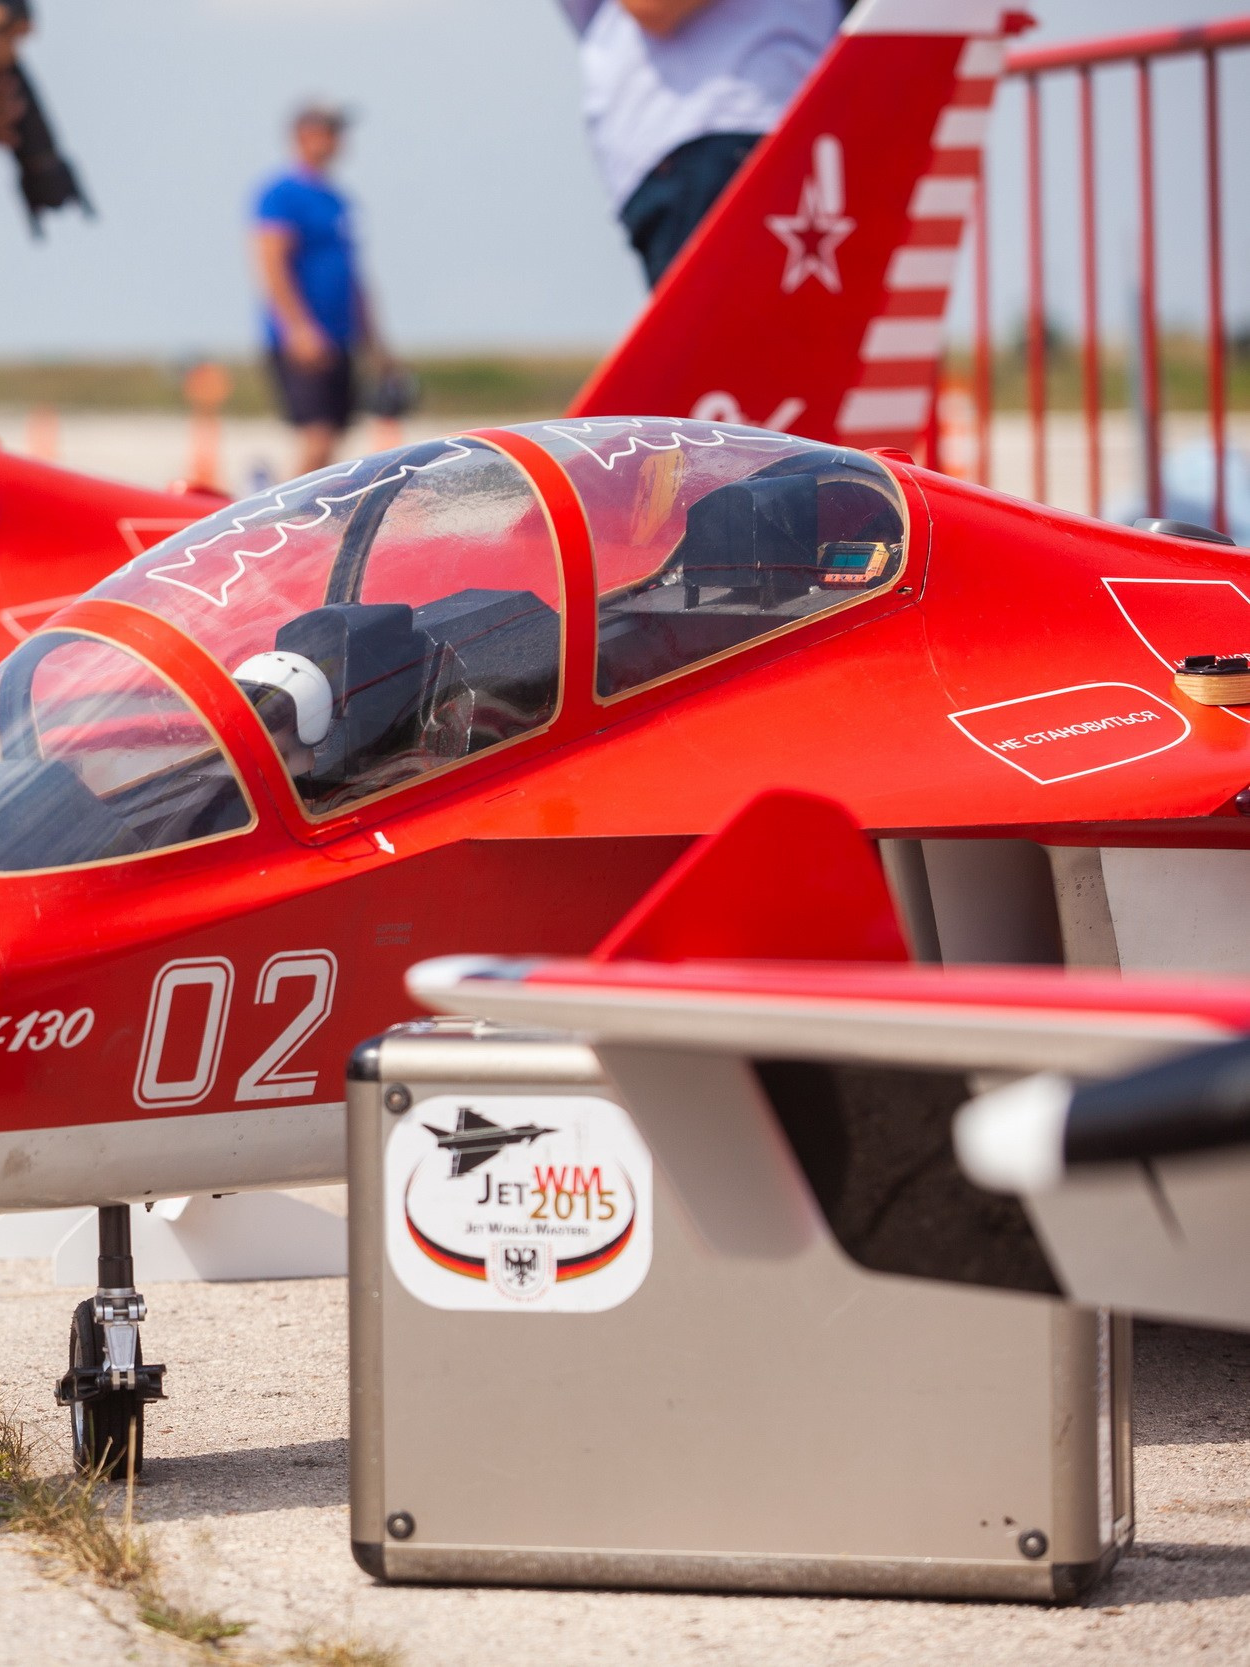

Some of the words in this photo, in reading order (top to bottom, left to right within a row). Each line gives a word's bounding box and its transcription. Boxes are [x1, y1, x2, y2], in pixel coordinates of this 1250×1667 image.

[992, 738, 1027, 752] НЕ
[1024, 710, 1161, 746] СТАНОВИТЬСЯ
[132, 948, 338, 1110] 02
[534, 1166, 603, 1196] WM
[530, 1190, 617, 1221] 2015
